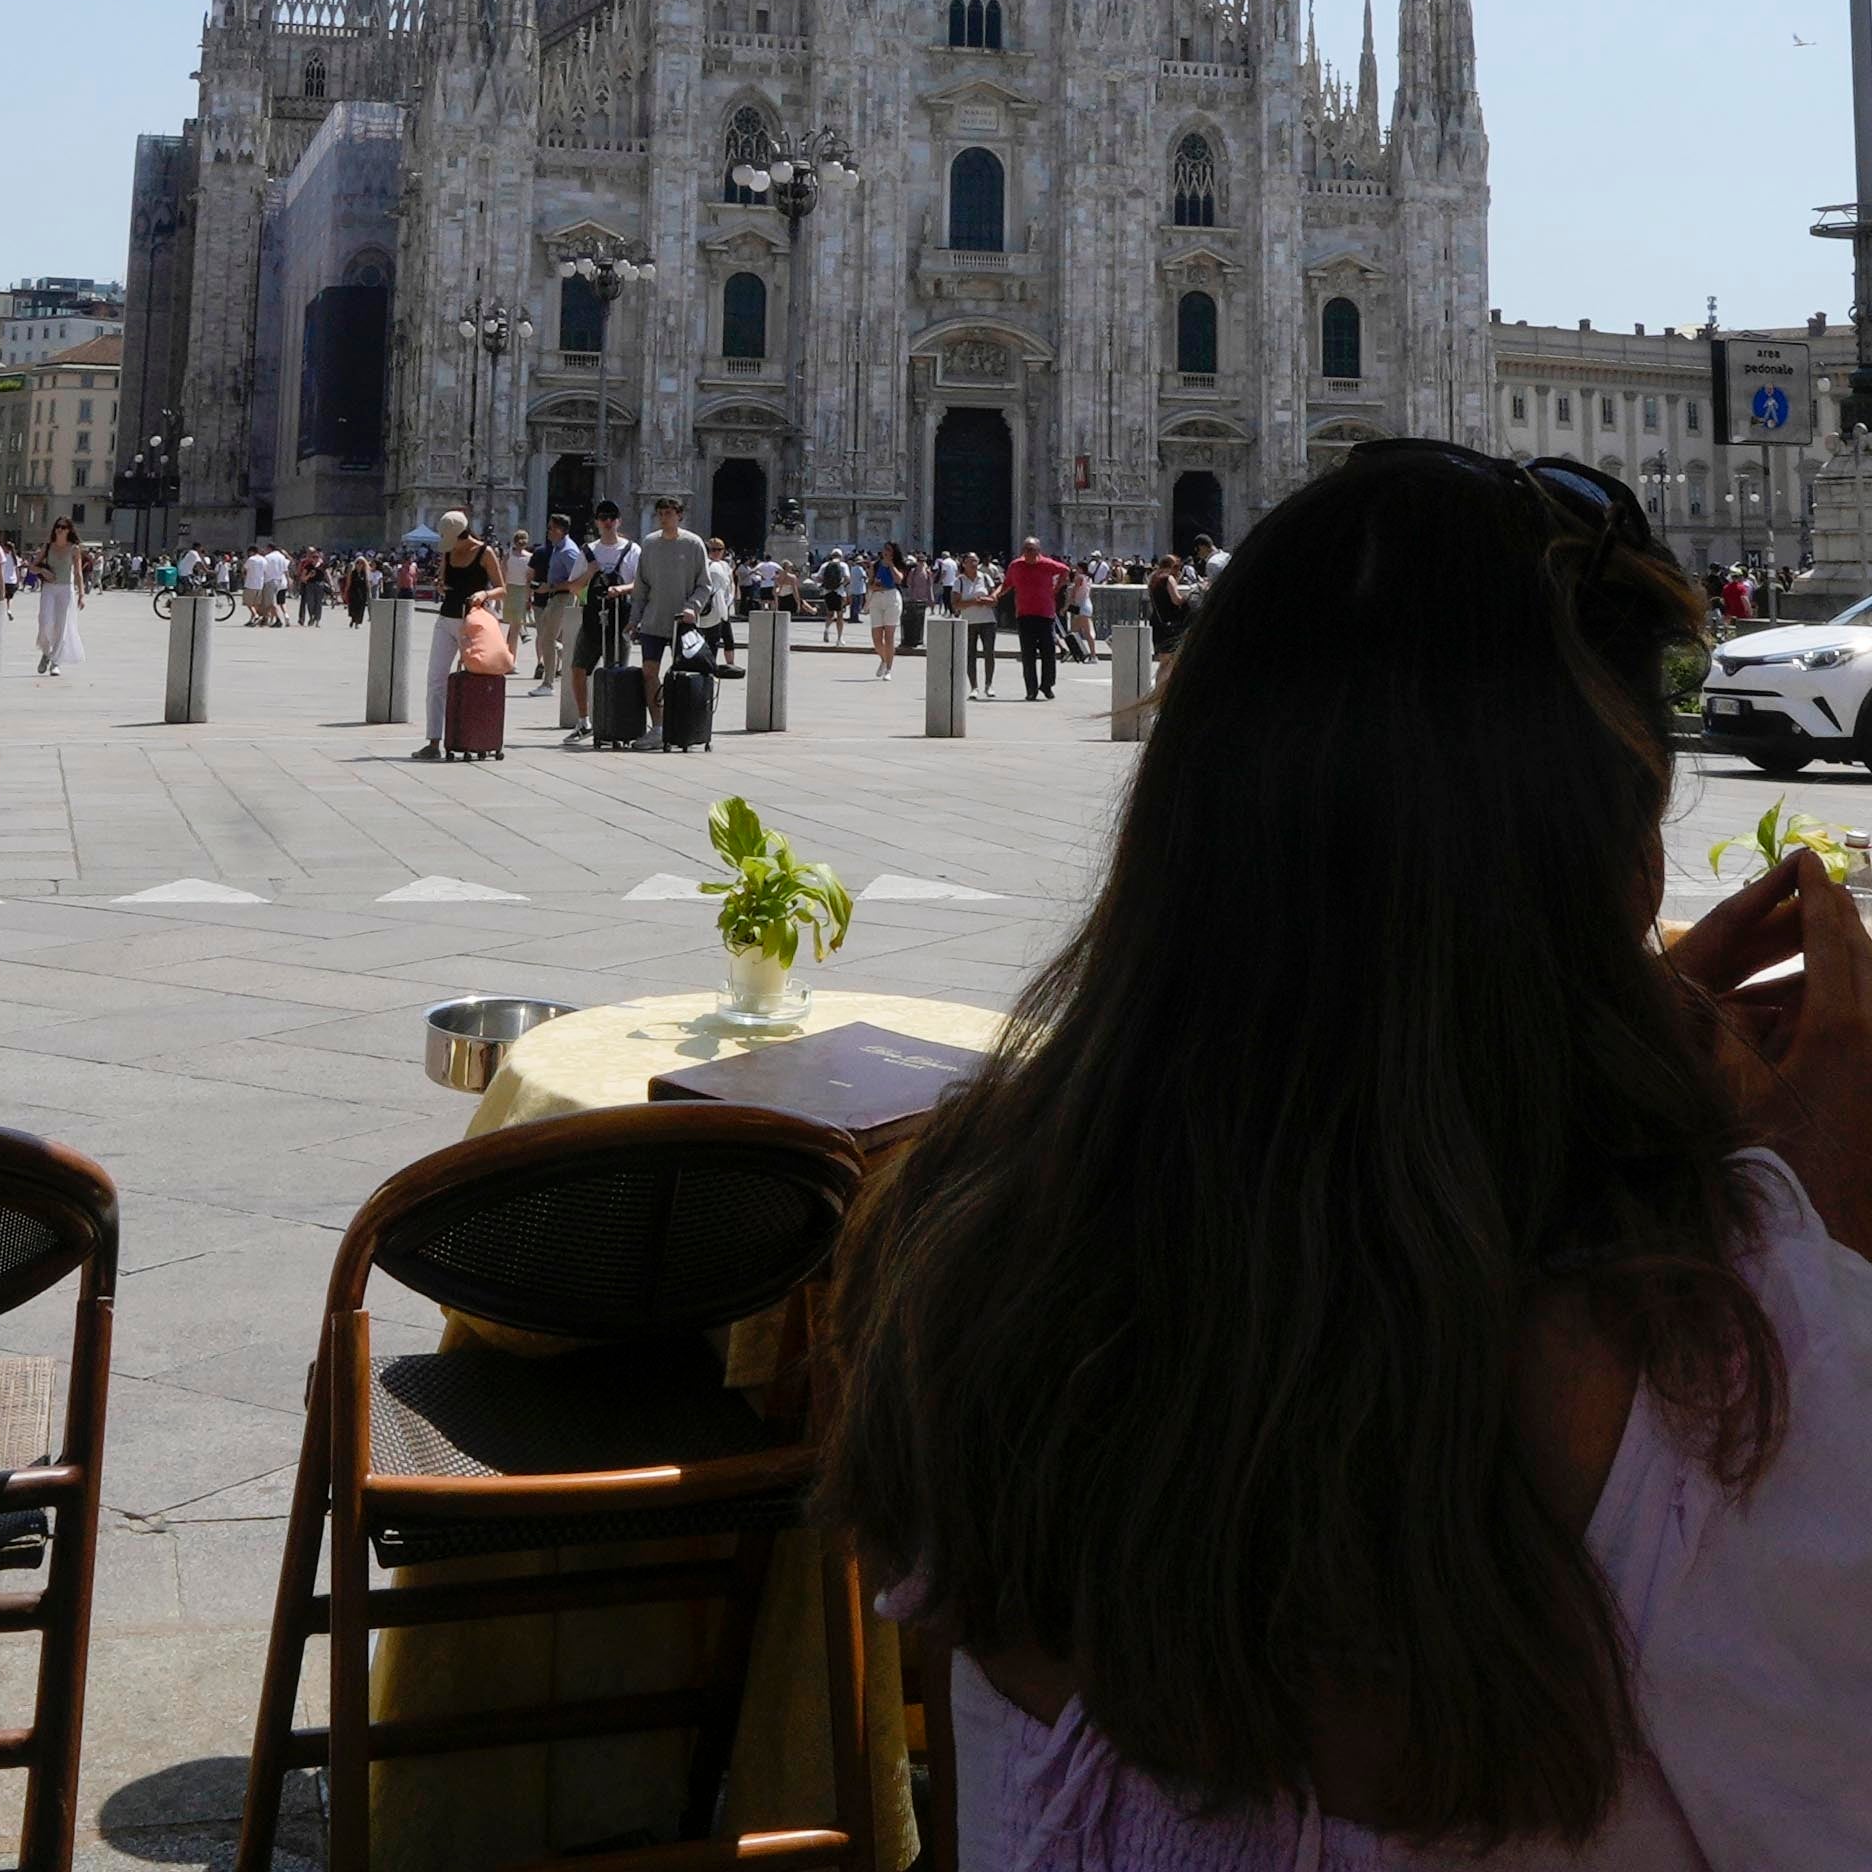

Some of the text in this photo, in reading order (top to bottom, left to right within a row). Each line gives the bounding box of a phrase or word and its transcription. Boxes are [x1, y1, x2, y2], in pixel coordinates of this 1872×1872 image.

[1757, 349, 1781, 358] area
[1744, 363, 1794, 375] pedonale
[1748, 552, 1760, 568] M
